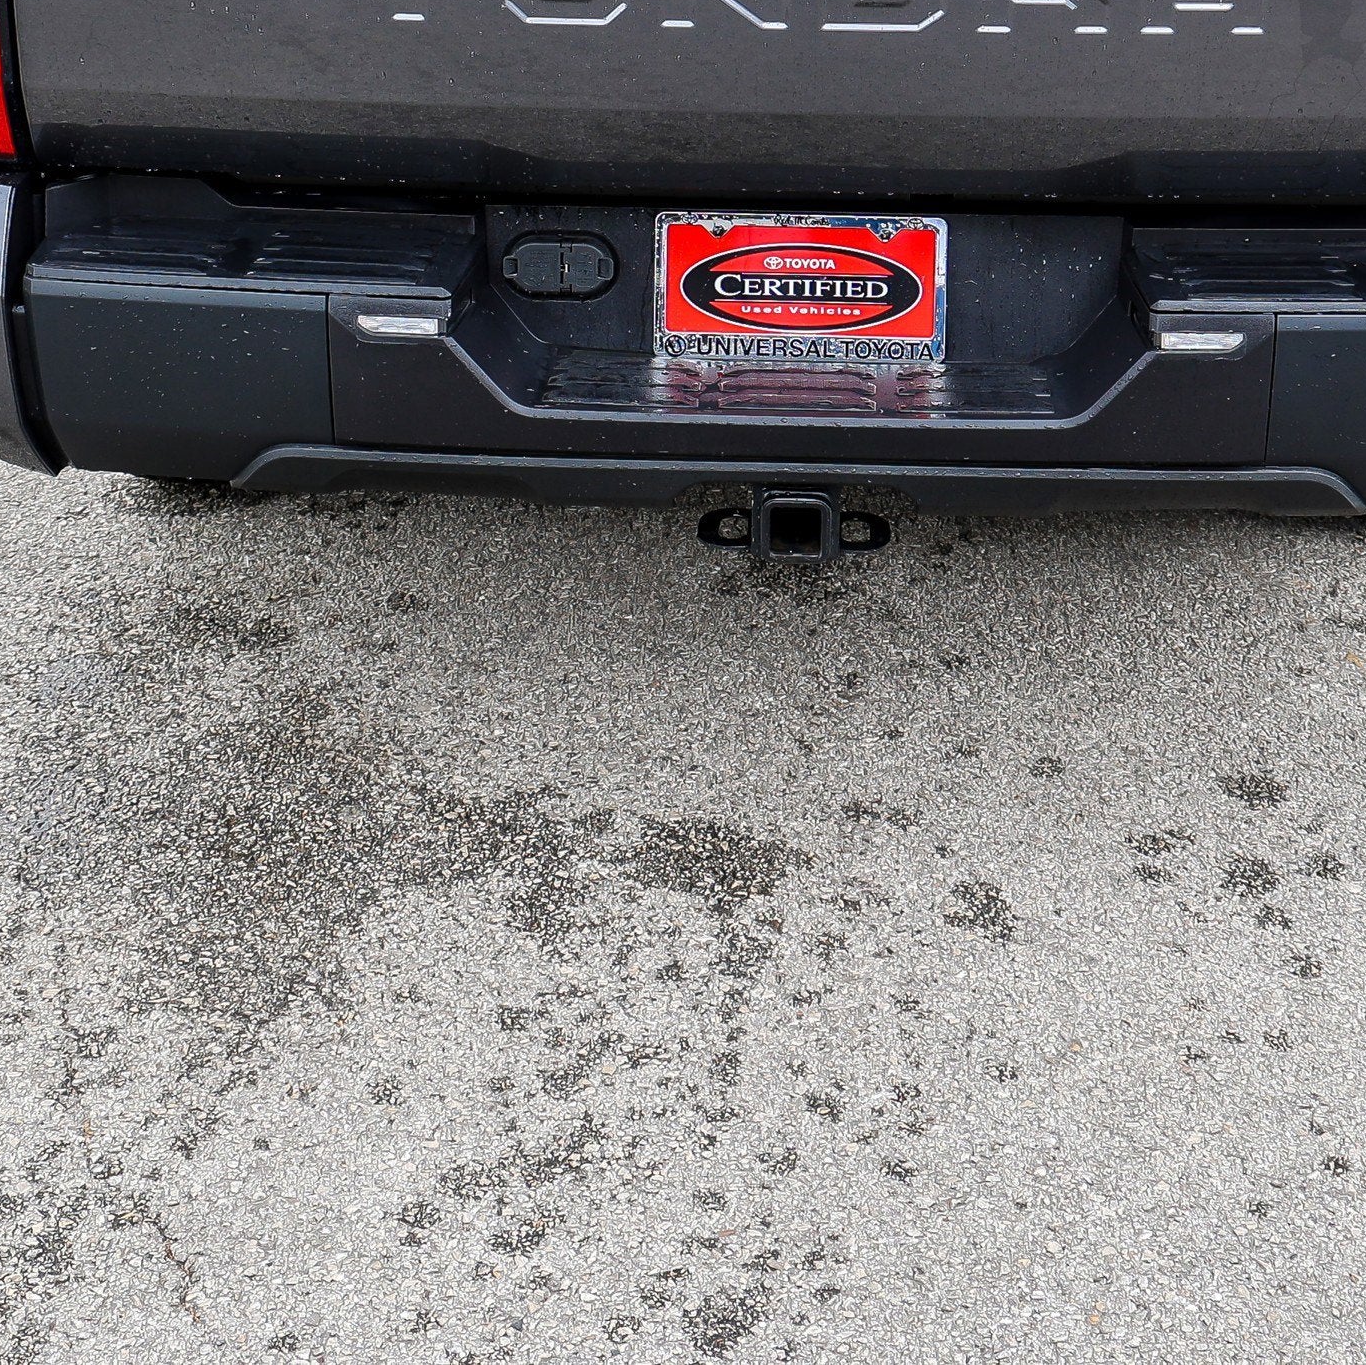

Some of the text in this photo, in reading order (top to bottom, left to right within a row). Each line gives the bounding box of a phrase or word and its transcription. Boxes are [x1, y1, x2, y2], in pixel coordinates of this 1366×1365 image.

[783, 257, 836, 270] TOYOTA
[741, 305, 861, 316] Used Vehicles
[696, 336, 935, 361] UNIVERSAL TOYOTA
